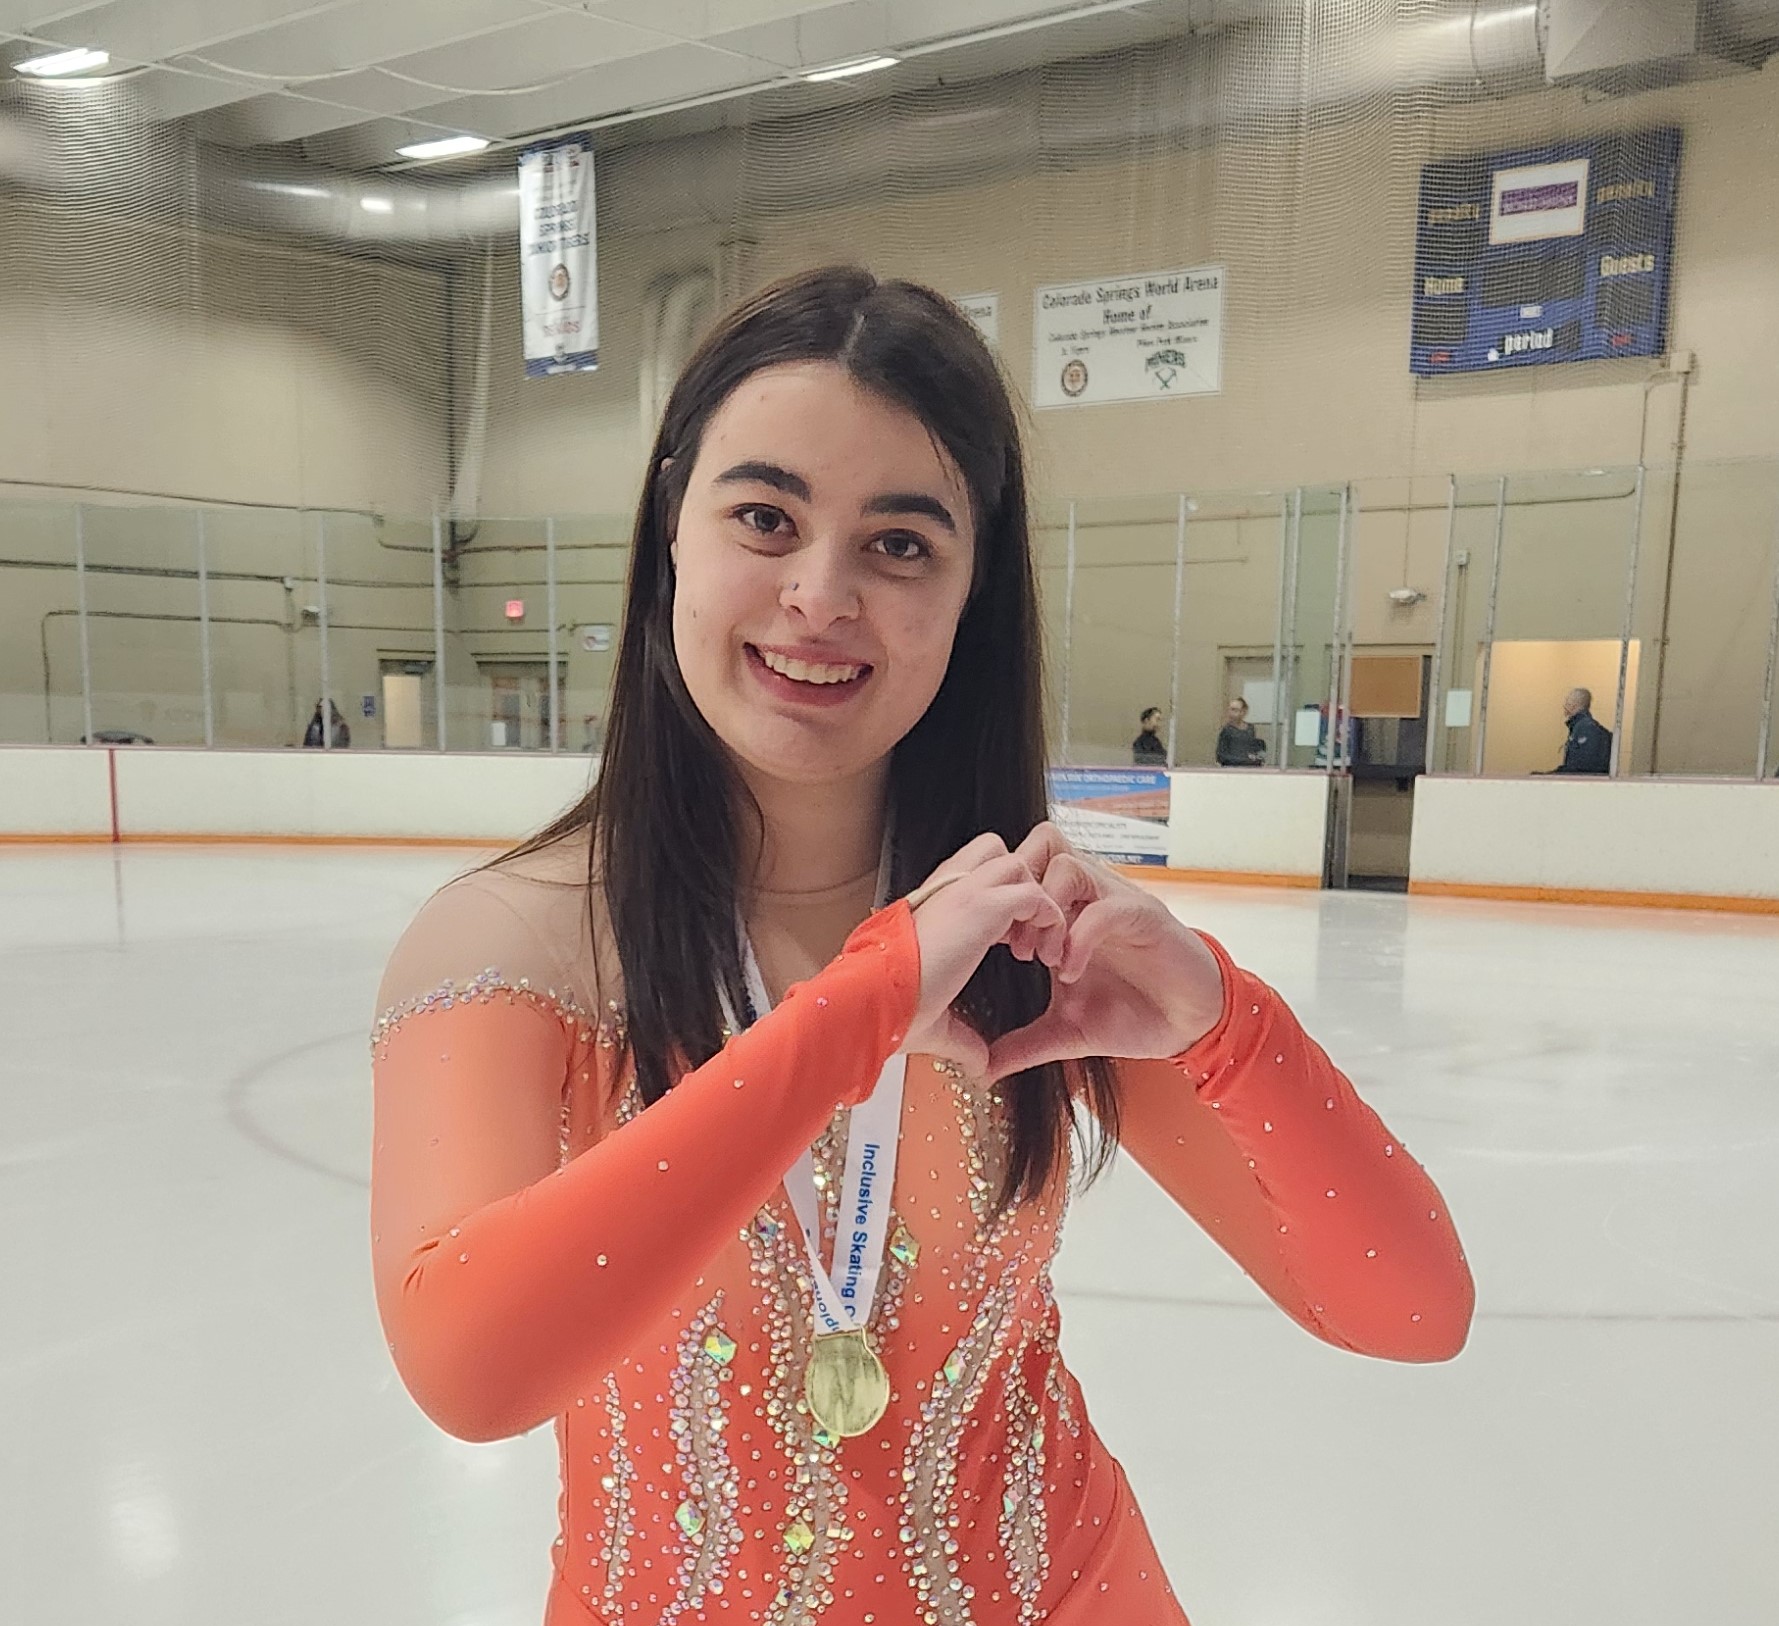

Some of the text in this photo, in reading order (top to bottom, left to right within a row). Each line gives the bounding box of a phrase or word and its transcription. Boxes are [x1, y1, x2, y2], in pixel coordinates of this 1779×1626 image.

[1600, 253, 1656, 277] Guests
[1041, 275, 1219, 310] Colorado Springs World Arena
[1102, 304, 1153, 325] Home of
[1504, 327, 1555, 354] period
[855, 1143, 880, 1225] Inclusive
[841, 1231, 868, 1298] Skating
